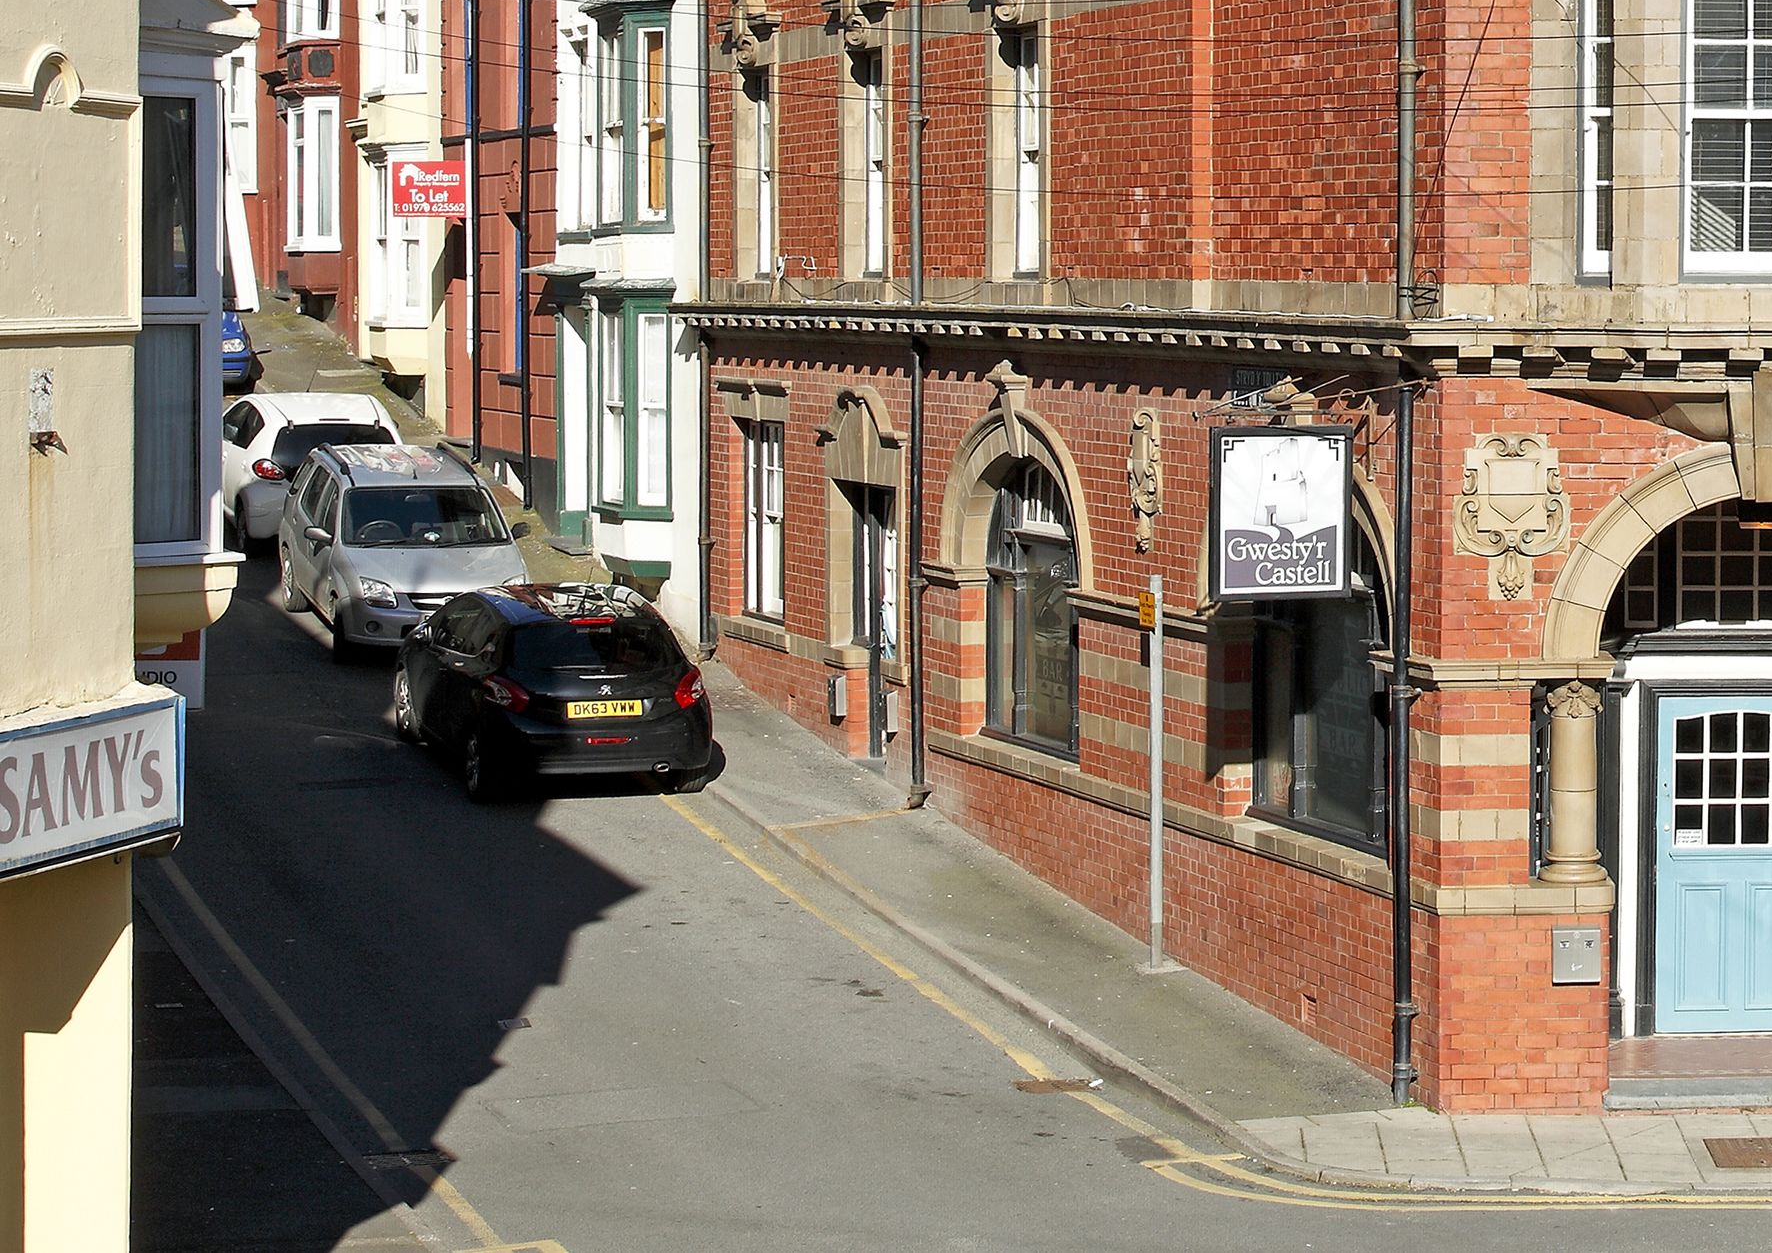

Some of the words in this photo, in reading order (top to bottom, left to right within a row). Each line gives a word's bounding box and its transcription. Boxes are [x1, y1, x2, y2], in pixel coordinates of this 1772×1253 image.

[418, 169, 460, 182] Redfern
[409, 188, 426, 203] To
[429, 188, 449, 203] Let
[431, 203, 465, 212] 625562
[1227, 535, 1327, 564] Gwesty'r
[1255, 560, 1331, 585] Castell
[142, 670, 177, 684] DIO
[1042, 658, 1063, 682] BAR
[573, 703, 608, 716] DK63
[611, 702, 635, 713] VWW
[0, 729, 163, 845] SAMY's
